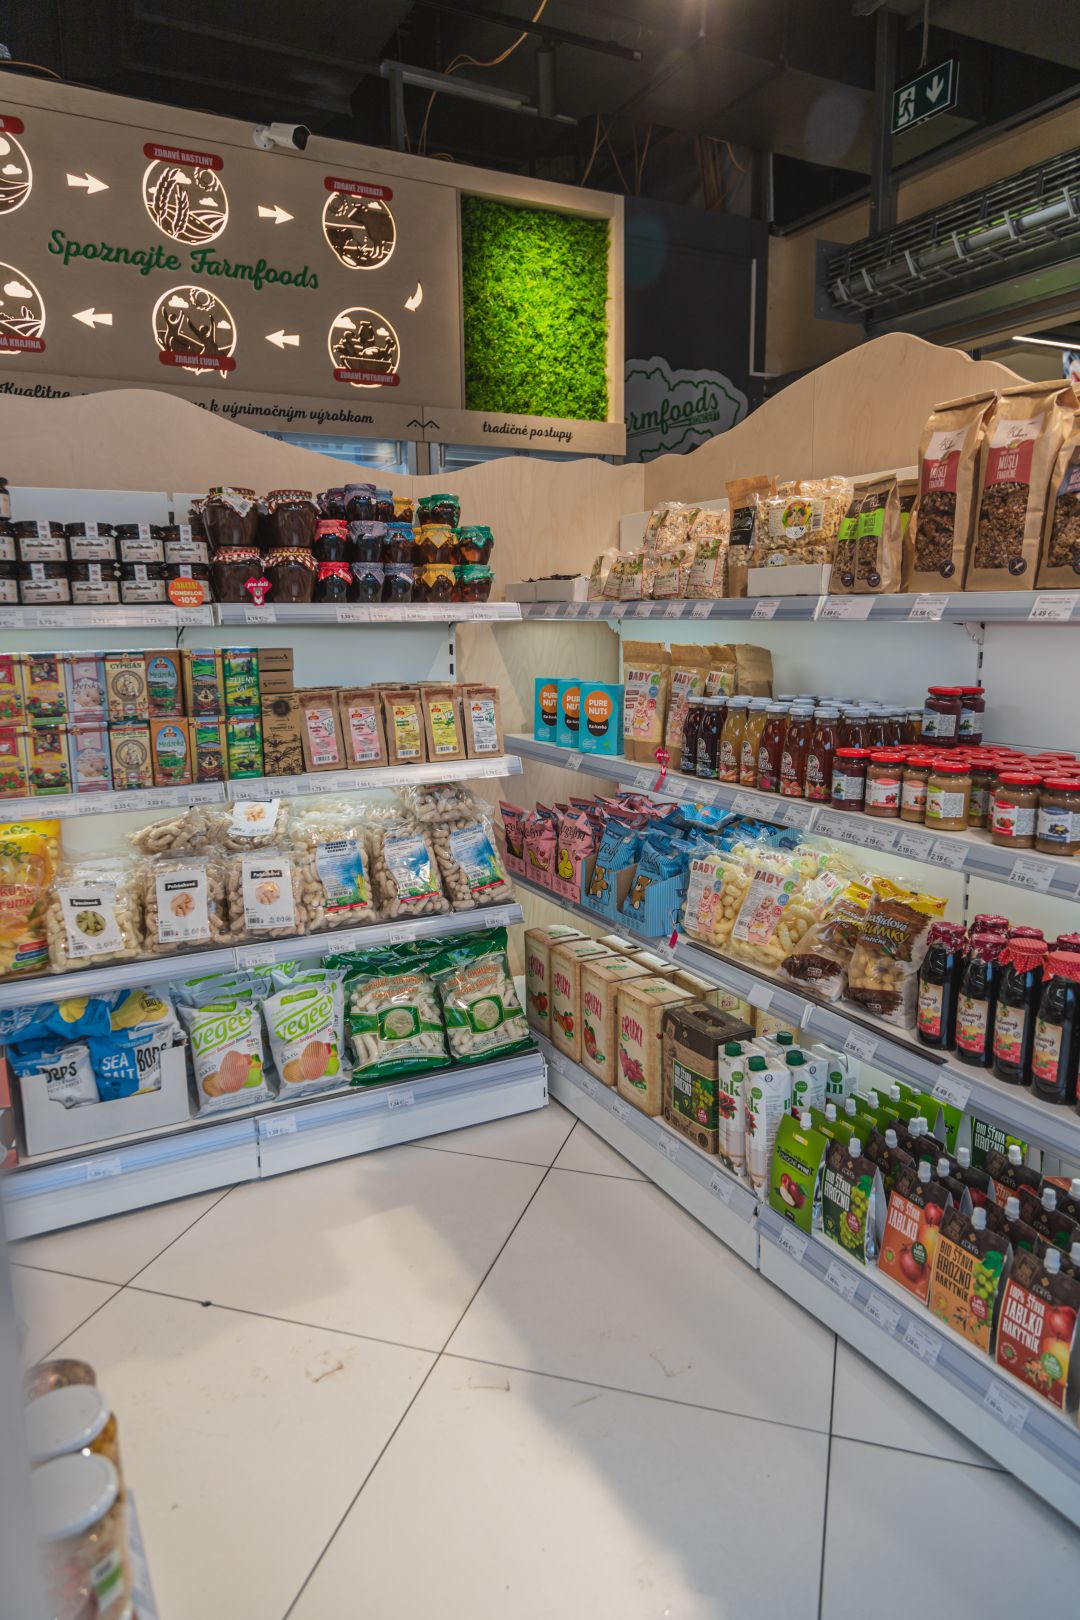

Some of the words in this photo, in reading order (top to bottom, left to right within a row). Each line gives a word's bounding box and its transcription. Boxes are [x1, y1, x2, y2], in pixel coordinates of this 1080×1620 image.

[47, 229, 182, 276] Spoznajte
[190, 248, 319, 291] Farmfoods
[211, 399, 219, 413] k
[222, 402, 306, 425] výnimočným
[309, 406, 373, 424] výrobkom
[482, 420, 528, 437] tradičné
[529, 424, 573, 443] postupy
[628, 671, 651, 681] BABY
[566, 695, 580, 703] PUR
[588, 699, 608, 707] PURE
[588, 707, 608, 715] NUTS
[692, 860, 715, 875] BABY
[753, 869, 784, 887] BABY
[1010, 873, 1025, 882] 2,19
[554, 971, 571, 1000] FRUXI
[276, 1000, 331, 1040] vegee
[584, 991, 602, 1022] FRUXI
[190, 1010, 252, 1050] vegee
[621, 1015, 643, 1048] FRUXI
[102, 1053, 129, 1071] SEA
[976, 1121, 986, 1134] BIO
[987, 1125, 1005, 1145] ŠŤAVA
[824, 1183, 850, 1212] HROZNO
[835, 1173, 851, 1194] ŠŤAVA
[904, 1201, 921, 1221] ŠŤAVA
[888, 1213, 919, 1241] JABLKO
[940, 1239, 951, 1257] BIO
[953, 1248, 974, 1273] ŠŤAVA
[936, 1253, 972, 1291] HROZNO
[935, 1273, 969, 1303] RAKYTNÍK
[1010, 1284, 1025, 1303] 100%
[1027, 1293, 1045, 1316] ŠŤAVA
[1005, 1298, 1044, 1338] JABLKO
[1002, 1319, 1040, 1354] RAKYTNÍK
